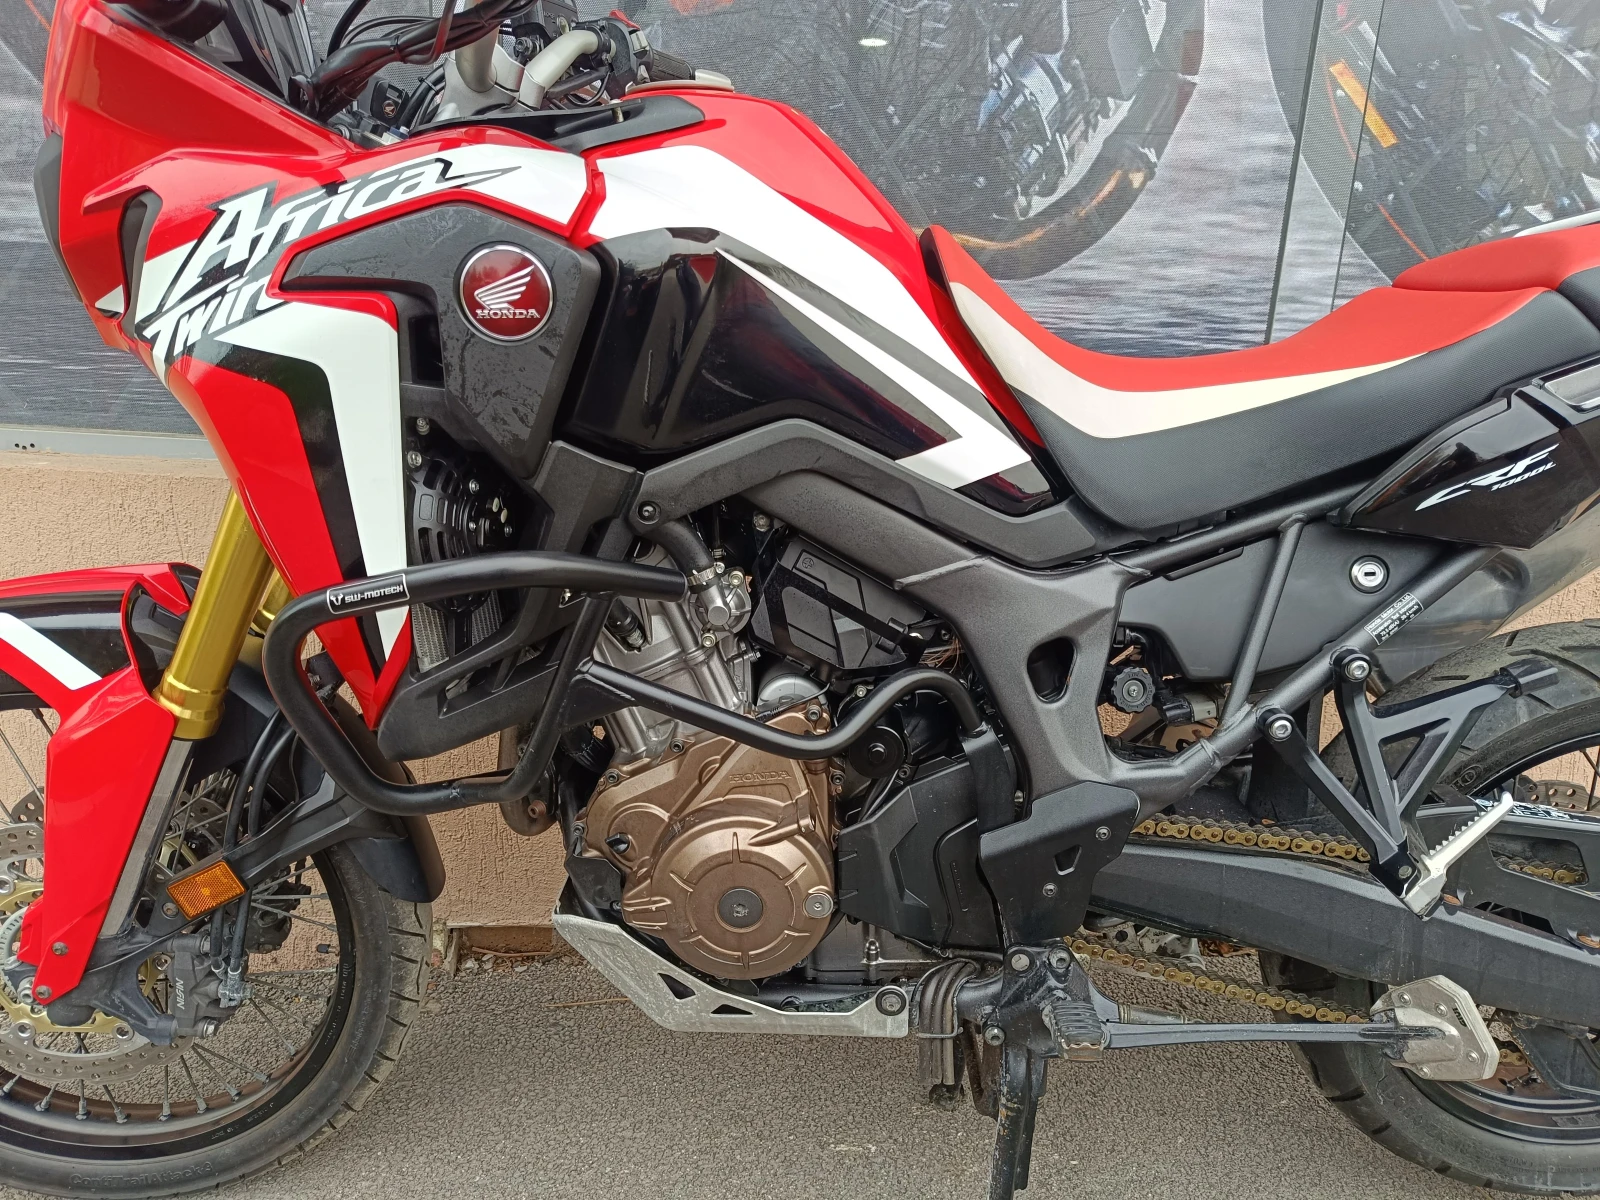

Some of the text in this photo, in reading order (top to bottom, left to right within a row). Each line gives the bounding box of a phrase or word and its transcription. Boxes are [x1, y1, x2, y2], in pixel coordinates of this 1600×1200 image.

[162, 157, 518, 312] Africa
[142, 271, 277, 357] Twin
[475, 308, 540, 319] HONDA
[1415, 443, 1559, 511] CRF
[1490, 461, 1557, 491] 1000L
[344, 584, 404, 604] SW-MOTECH
[729, 770, 792, 784] HONDA
[175, 977, 185, 1010] NISSIN
